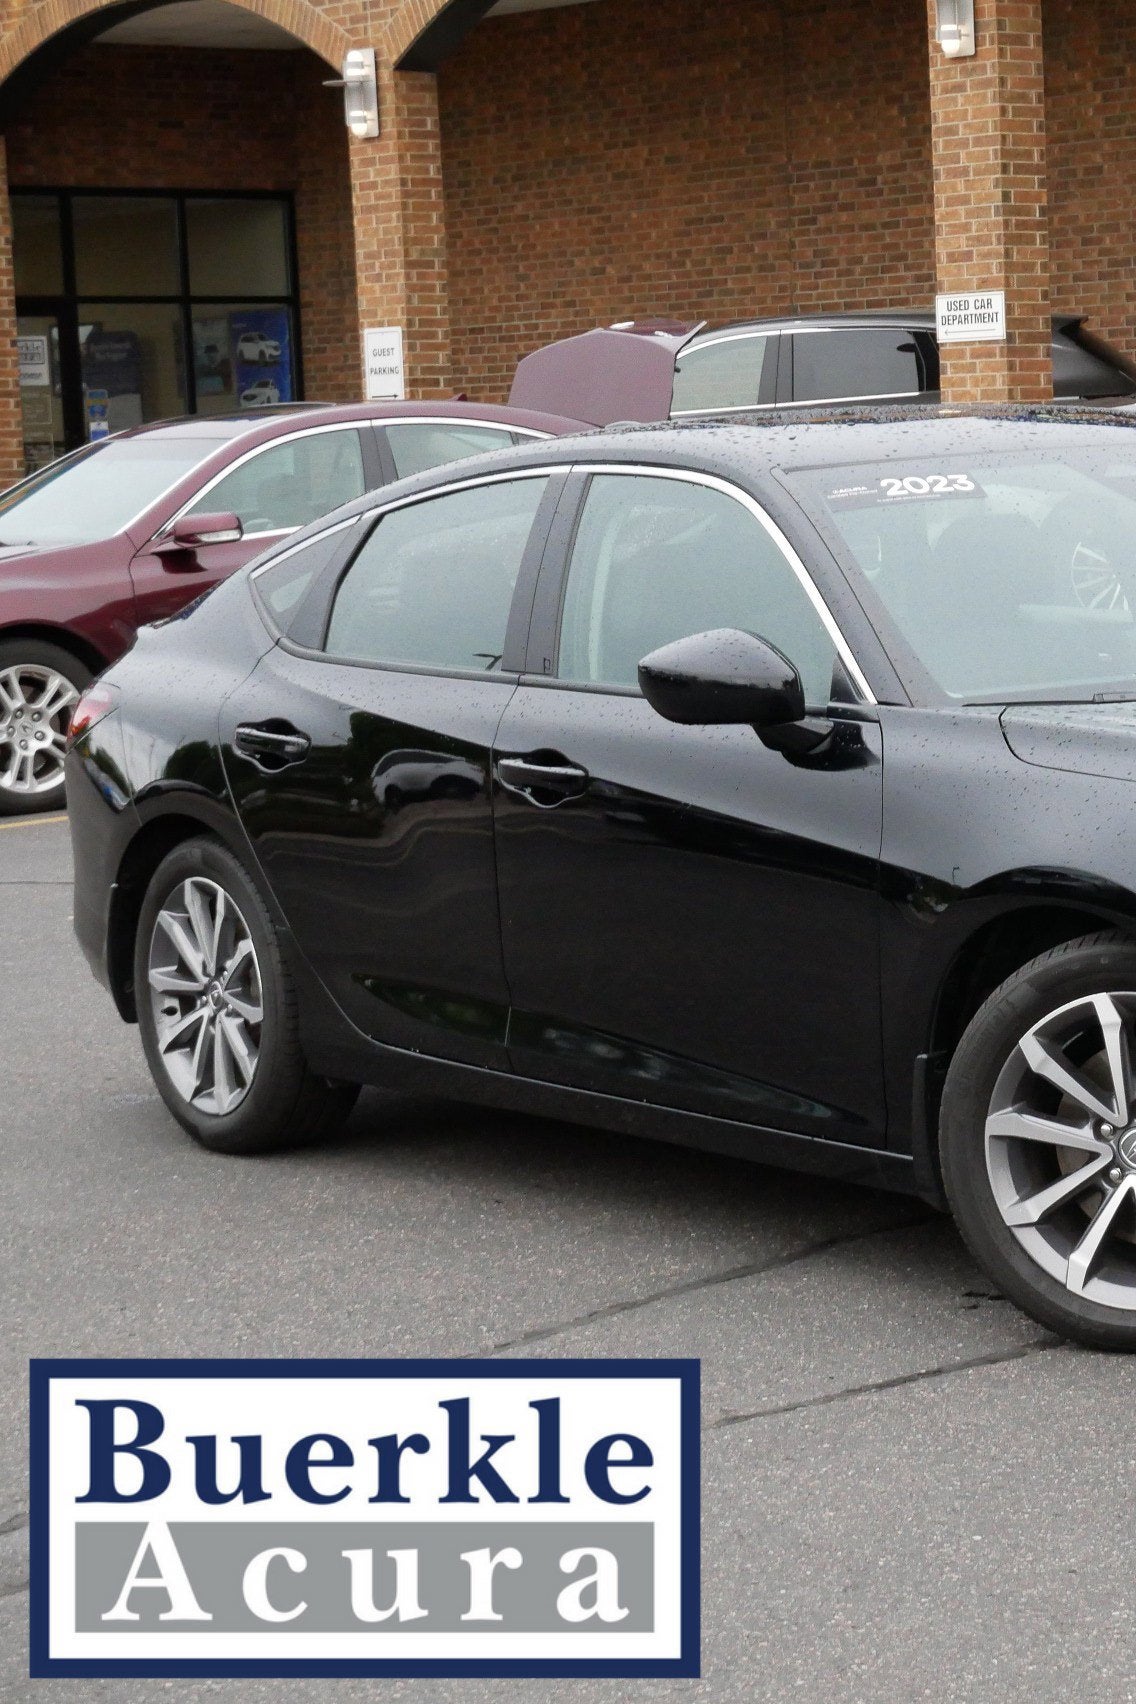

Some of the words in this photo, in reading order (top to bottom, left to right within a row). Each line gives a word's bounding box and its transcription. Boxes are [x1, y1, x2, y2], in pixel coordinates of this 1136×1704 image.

[946, 299, 970, 312] USED
[974, 298, 993, 310] CAR
[941, 312, 999, 326] DEPARTMENT
[372, 347, 395, 357] GUEST
[370, 366, 399, 375] PARKING
[880, 474, 975, 496] 2023
